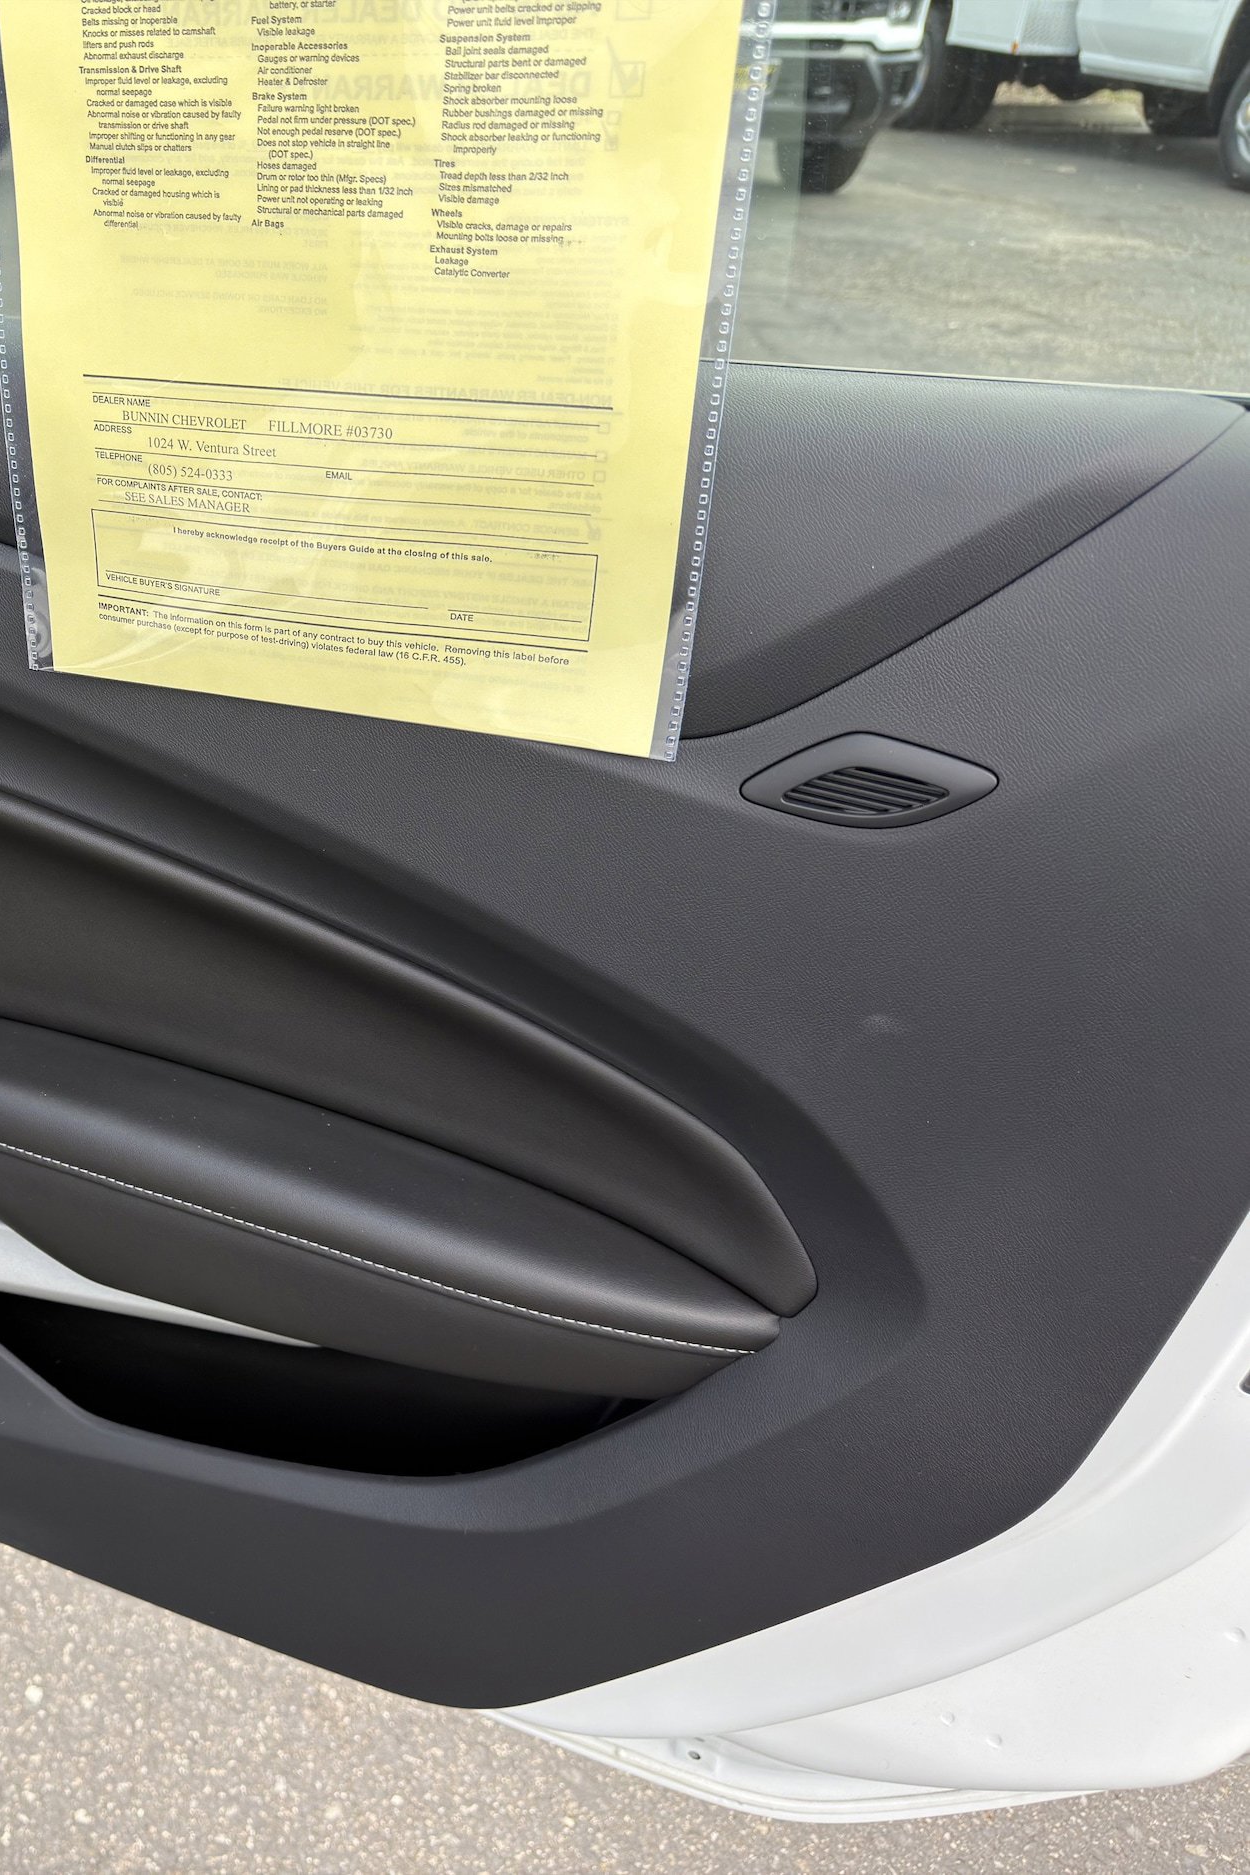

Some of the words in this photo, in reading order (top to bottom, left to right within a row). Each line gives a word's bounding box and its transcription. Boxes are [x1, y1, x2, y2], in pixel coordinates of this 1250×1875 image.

[250, 15, 270, 25] Fuel
[270, 15, 303, 25] System
[82, 29, 109, 37] Knocks
[119, 29, 145, 37] misses
[146, 27, 172, 36] related
[172, 27, 180, 36] to
[181, 26, 216, 35] camshaft
[257, 27, 284, 36] Visible
[284, 27, 316, 37] leakage
[438, 34, 494, 44] Suspension
[495, 33, 531, 43] System
[251, 42, 296, 52] Inoperable
[297, 41, 348, 50] Accessories
[83, 51, 118, 60] Abnormal
[118, 51, 148, 59] exhaust
[148, 51, 184, 60] discharge
[257, 54, 288, 64] Gauges
[298, 53, 330, 63] warning
[330, 53, 360, 62] devices
[444, 59, 486, 68] Structural
[487, 59, 510, 69] parts
[511, 58, 532, 67] bent
[532, 58, 542, 67] or
[543, 56, 587, 67] damaged
[79, 66, 130, 74] Transmission
[131, 65, 137, 73] &
[138, 65, 159, 73] Drive
[160, 64, 182, 73] Shaft
[256, 66, 269, 75] Air
[269, 65, 313, 74] conditioner
[257, 77, 284, 86] Heater
[284, 77, 291, 86] &
[292, 77, 328, 86] Defroster
[443, 83, 471, 94] Spring
[471, 83, 502, 93] broken
[251, 92, 275, 100] Brake
[276, 92, 307, 102] System
[98, 121, 142, 129] transmission
[151, 121, 169, 129] drive
[170, 121, 189, 129] shaft
[85, 155, 125, 164] Differential
[434, 158, 456, 168] Tires
[256, 161, 281, 170] Hoses
[281, 162, 317, 172] damaged
[438, 182, 461, 192] Sizes
[461, 184, 513, 193] mismatched
[438, 194, 465, 203] Visible
[466, 195, 500, 206] damage
[431, 208, 463, 217] Wheels
[251, 218, 263, 227] Air
[264, 219, 284, 229] Bags
[429, 244, 465, 254] Exhaust
[465, 246, 498, 256] System
[434, 256, 469, 266] Leakage
[433, 267, 469, 277] Catalytic
[470, 268, 510, 278] Converter
[93, 396, 125, 405] DEALER
[126, 398, 151, 407] NAME
[122, 410, 169, 423] BUNNIN
[172, 415, 246, 430] CHEVROLET
[93, 423, 132, 434] ADDRESS
[268, 420, 342, 436] FILLMORE
[345, 425, 393, 439] #03730
[148, 437, 174, 449] 1024
[178, 439, 192, 450] W.
[196, 440, 239, 454] Ventura
[242, 444, 277, 457] Street
[96, 451, 143, 462] TELEPHONE
[148, 464, 177, 479] (805)
[180, 466, 233, 481] 524-0333
[325, 470, 353, 480] EMAIL
[96, 477, 114, 486] FOR
[114, 479, 167, 491] COMPLAINTS
[167, 482, 195, 494] AFTER
[196, 485, 220, 497] SALE,
[221, 487, 262, 500] CONTACT:
[124, 492, 146, 502] SEE
[148, 494, 184, 507] SALES
[187, 498, 250, 513] MANAGER
[172, 525, 176, 533] I
[177, 527, 205, 538] hereby
[205, 532, 258, 543] acknowledge
[259, 538, 289, 547] receipt
[289, 539, 299, 547] of
[300, 540, 314, 548] the
[316, 541, 347, 551] Buyers
[348, 544, 375, 553] Guide
[387, 547, 402, 555] the
[403, 549, 438, 559] closing
[439, 551, 450, 559] of
[451, 552, 469, 560] this
[470, 554, 492, 562] sale.
[105, 573, 138, 584] VEHICLE
[139, 578, 173, 589] BUYER'S
[174, 583, 221, 596] SIGNATURE
[449, 612, 474, 622] DATE
[98, 602, 149, 616] IMPORTANT:
[154, 610, 168, 620] The
[169, 613, 214, 625] information
[227, 620, 243, 629] this
[243, 622, 263, 632] form
[264, 625, 272, 633] is
[291, 629, 302, 637] of
[301, 631, 319, 640] any
[319, 634, 356, 643] contract
[356, 636, 367, 644] to
[367, 637, 385, 648] buy
[385, 639, 403, 648] this
[404, 642, 439, 652] vehicle.
[444, 644, 491, 658] Removing
[493, 649, 510, 658] this
[512, 651, 536, 661] label
[537, 654, 569, 665] before
[98, 613, 135, 624] consumer
[136, 619, 172, 630] purchase
[173, 624, 202, 635] (except
[203, 627, 215, 635] for
[216, 631, 249, 640] purpose
[260, 636, 310, 649] test-driving)
[311, 641, 344, 652] violates
[345, 645, 376, 656] federal
[377, 647, 394, 657] law
[395, 651, 410, 660] (16
[411, 652, 441, 662] C.F.R.
[442, 655, 466, 666] 455).
